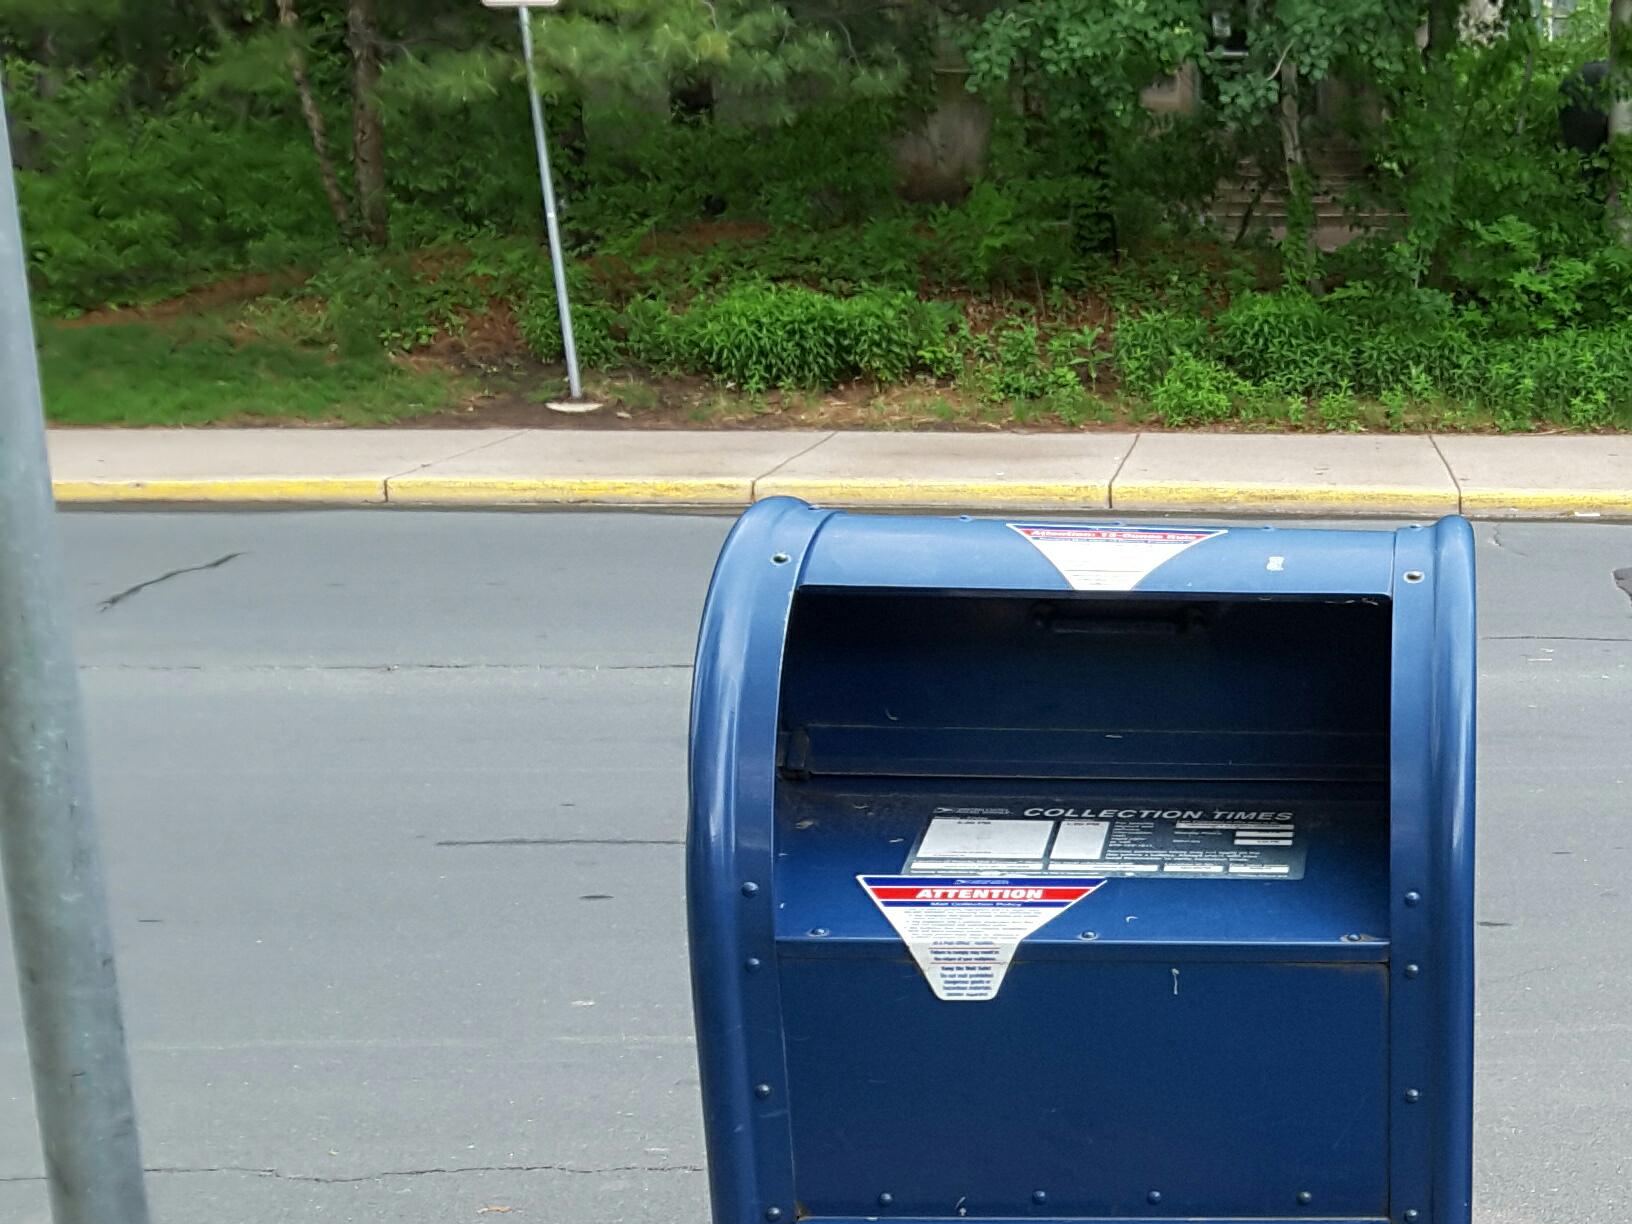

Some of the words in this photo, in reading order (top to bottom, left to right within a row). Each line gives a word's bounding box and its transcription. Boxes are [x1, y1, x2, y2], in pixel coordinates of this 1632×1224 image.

[1023, 807, 1203, 820] COLLECTION
[1213, 810, 1295, 821] TIMES
[916, 889, 1043, 899] ATTENTION
